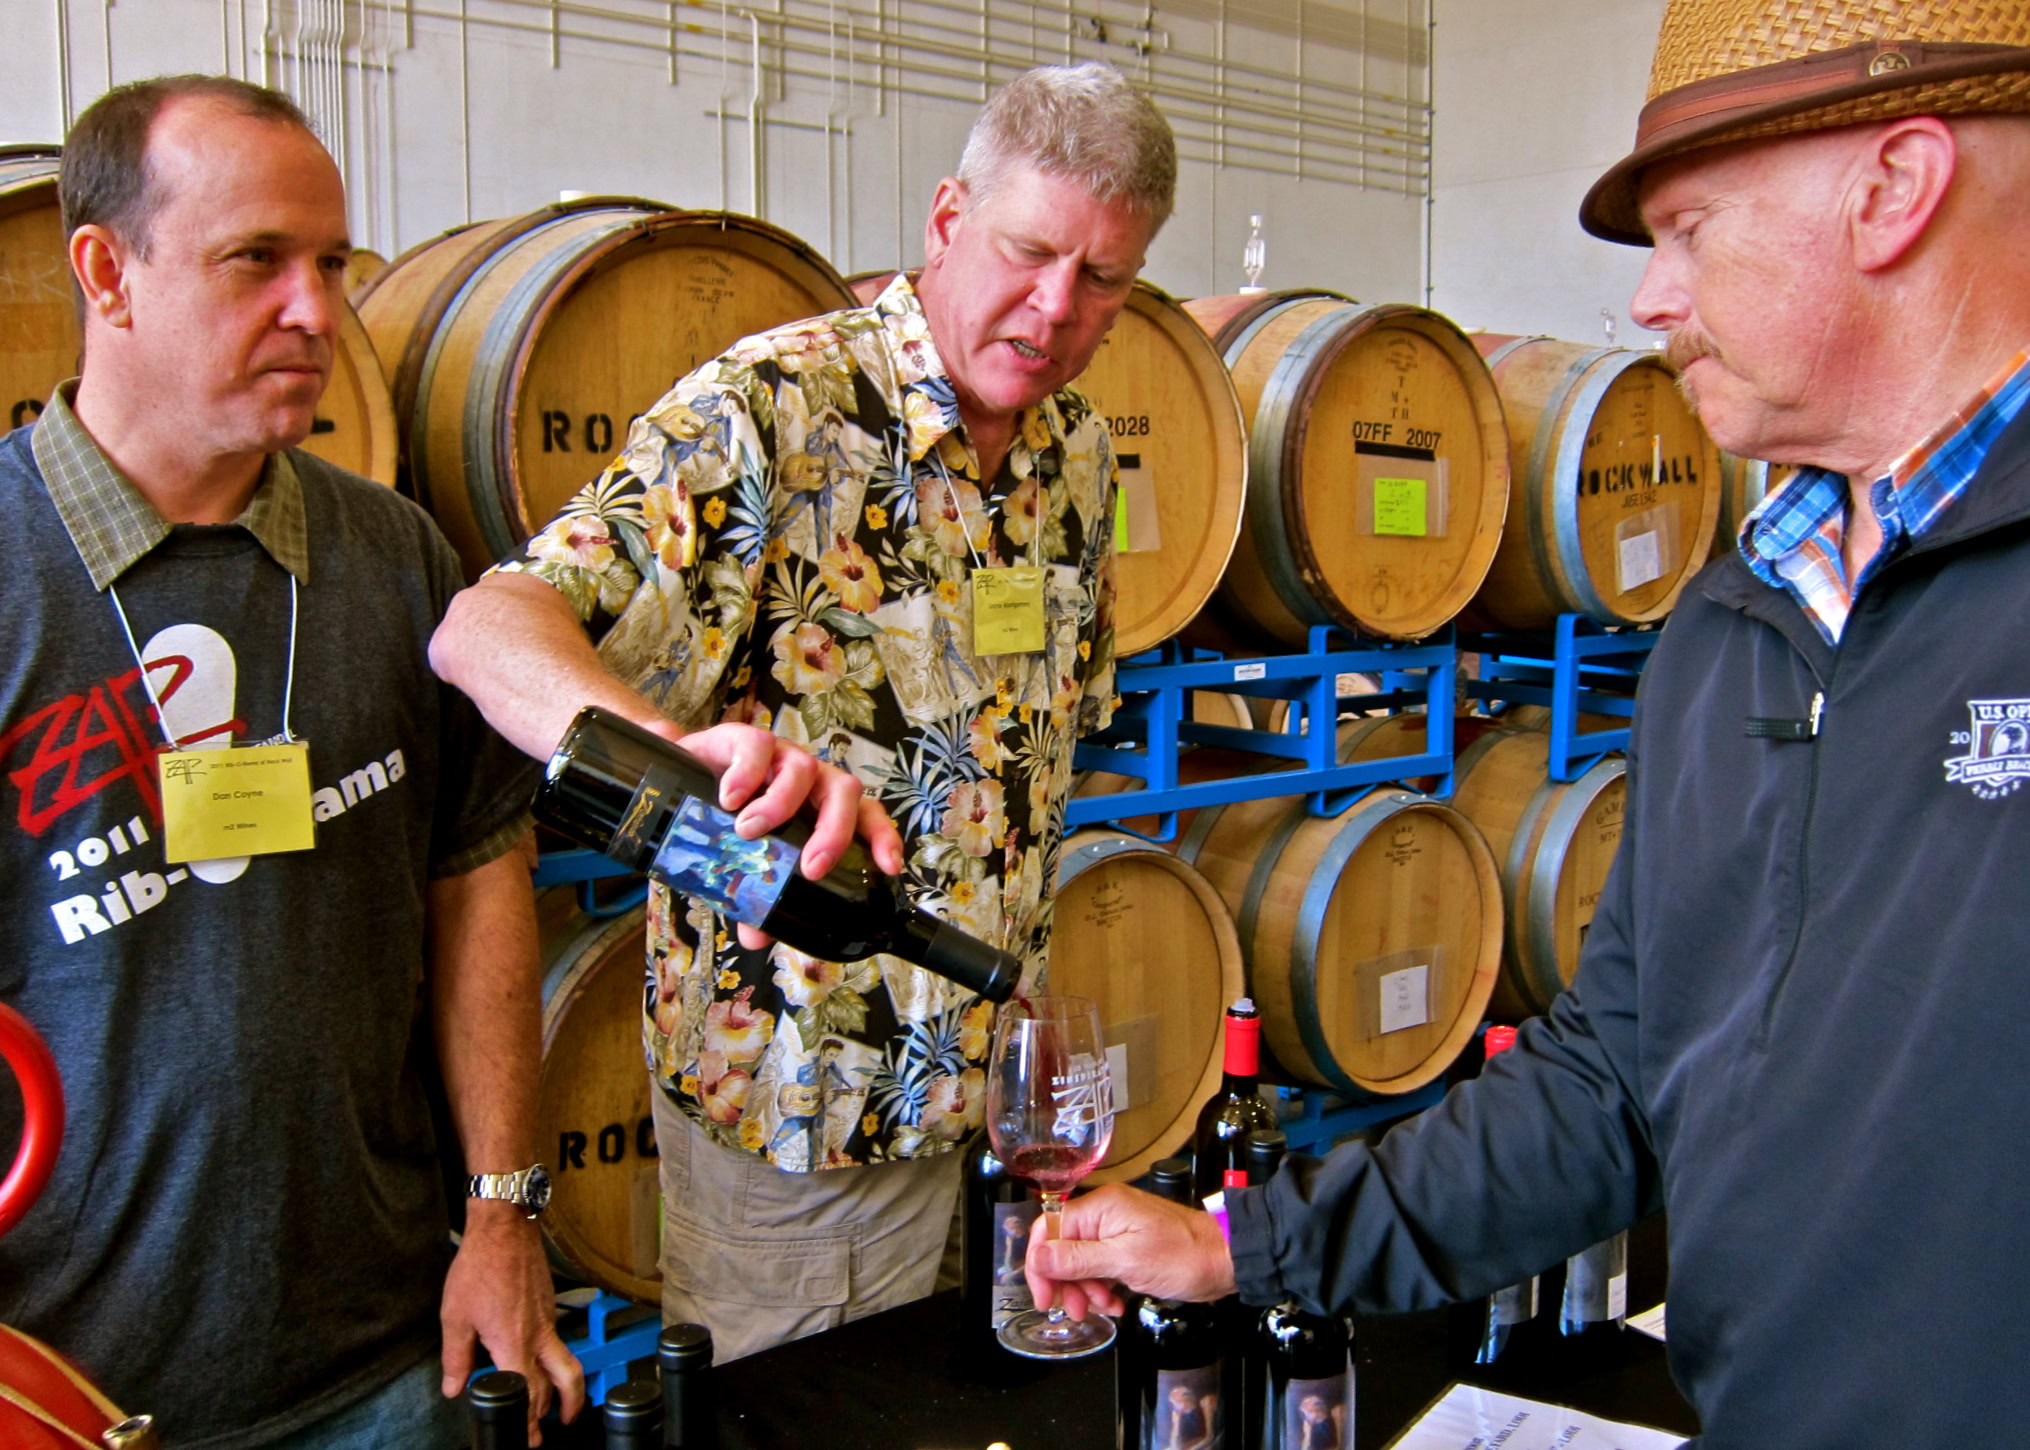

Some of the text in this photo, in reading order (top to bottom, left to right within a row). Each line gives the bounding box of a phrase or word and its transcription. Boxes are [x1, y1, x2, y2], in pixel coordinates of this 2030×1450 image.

[1352, 420, 1442, 449] 07FF 2007
[1949, 731, 1970, 744] 20
[233, 789, 264, 800] Coyne
[49, 816, 150, 881] 2011
